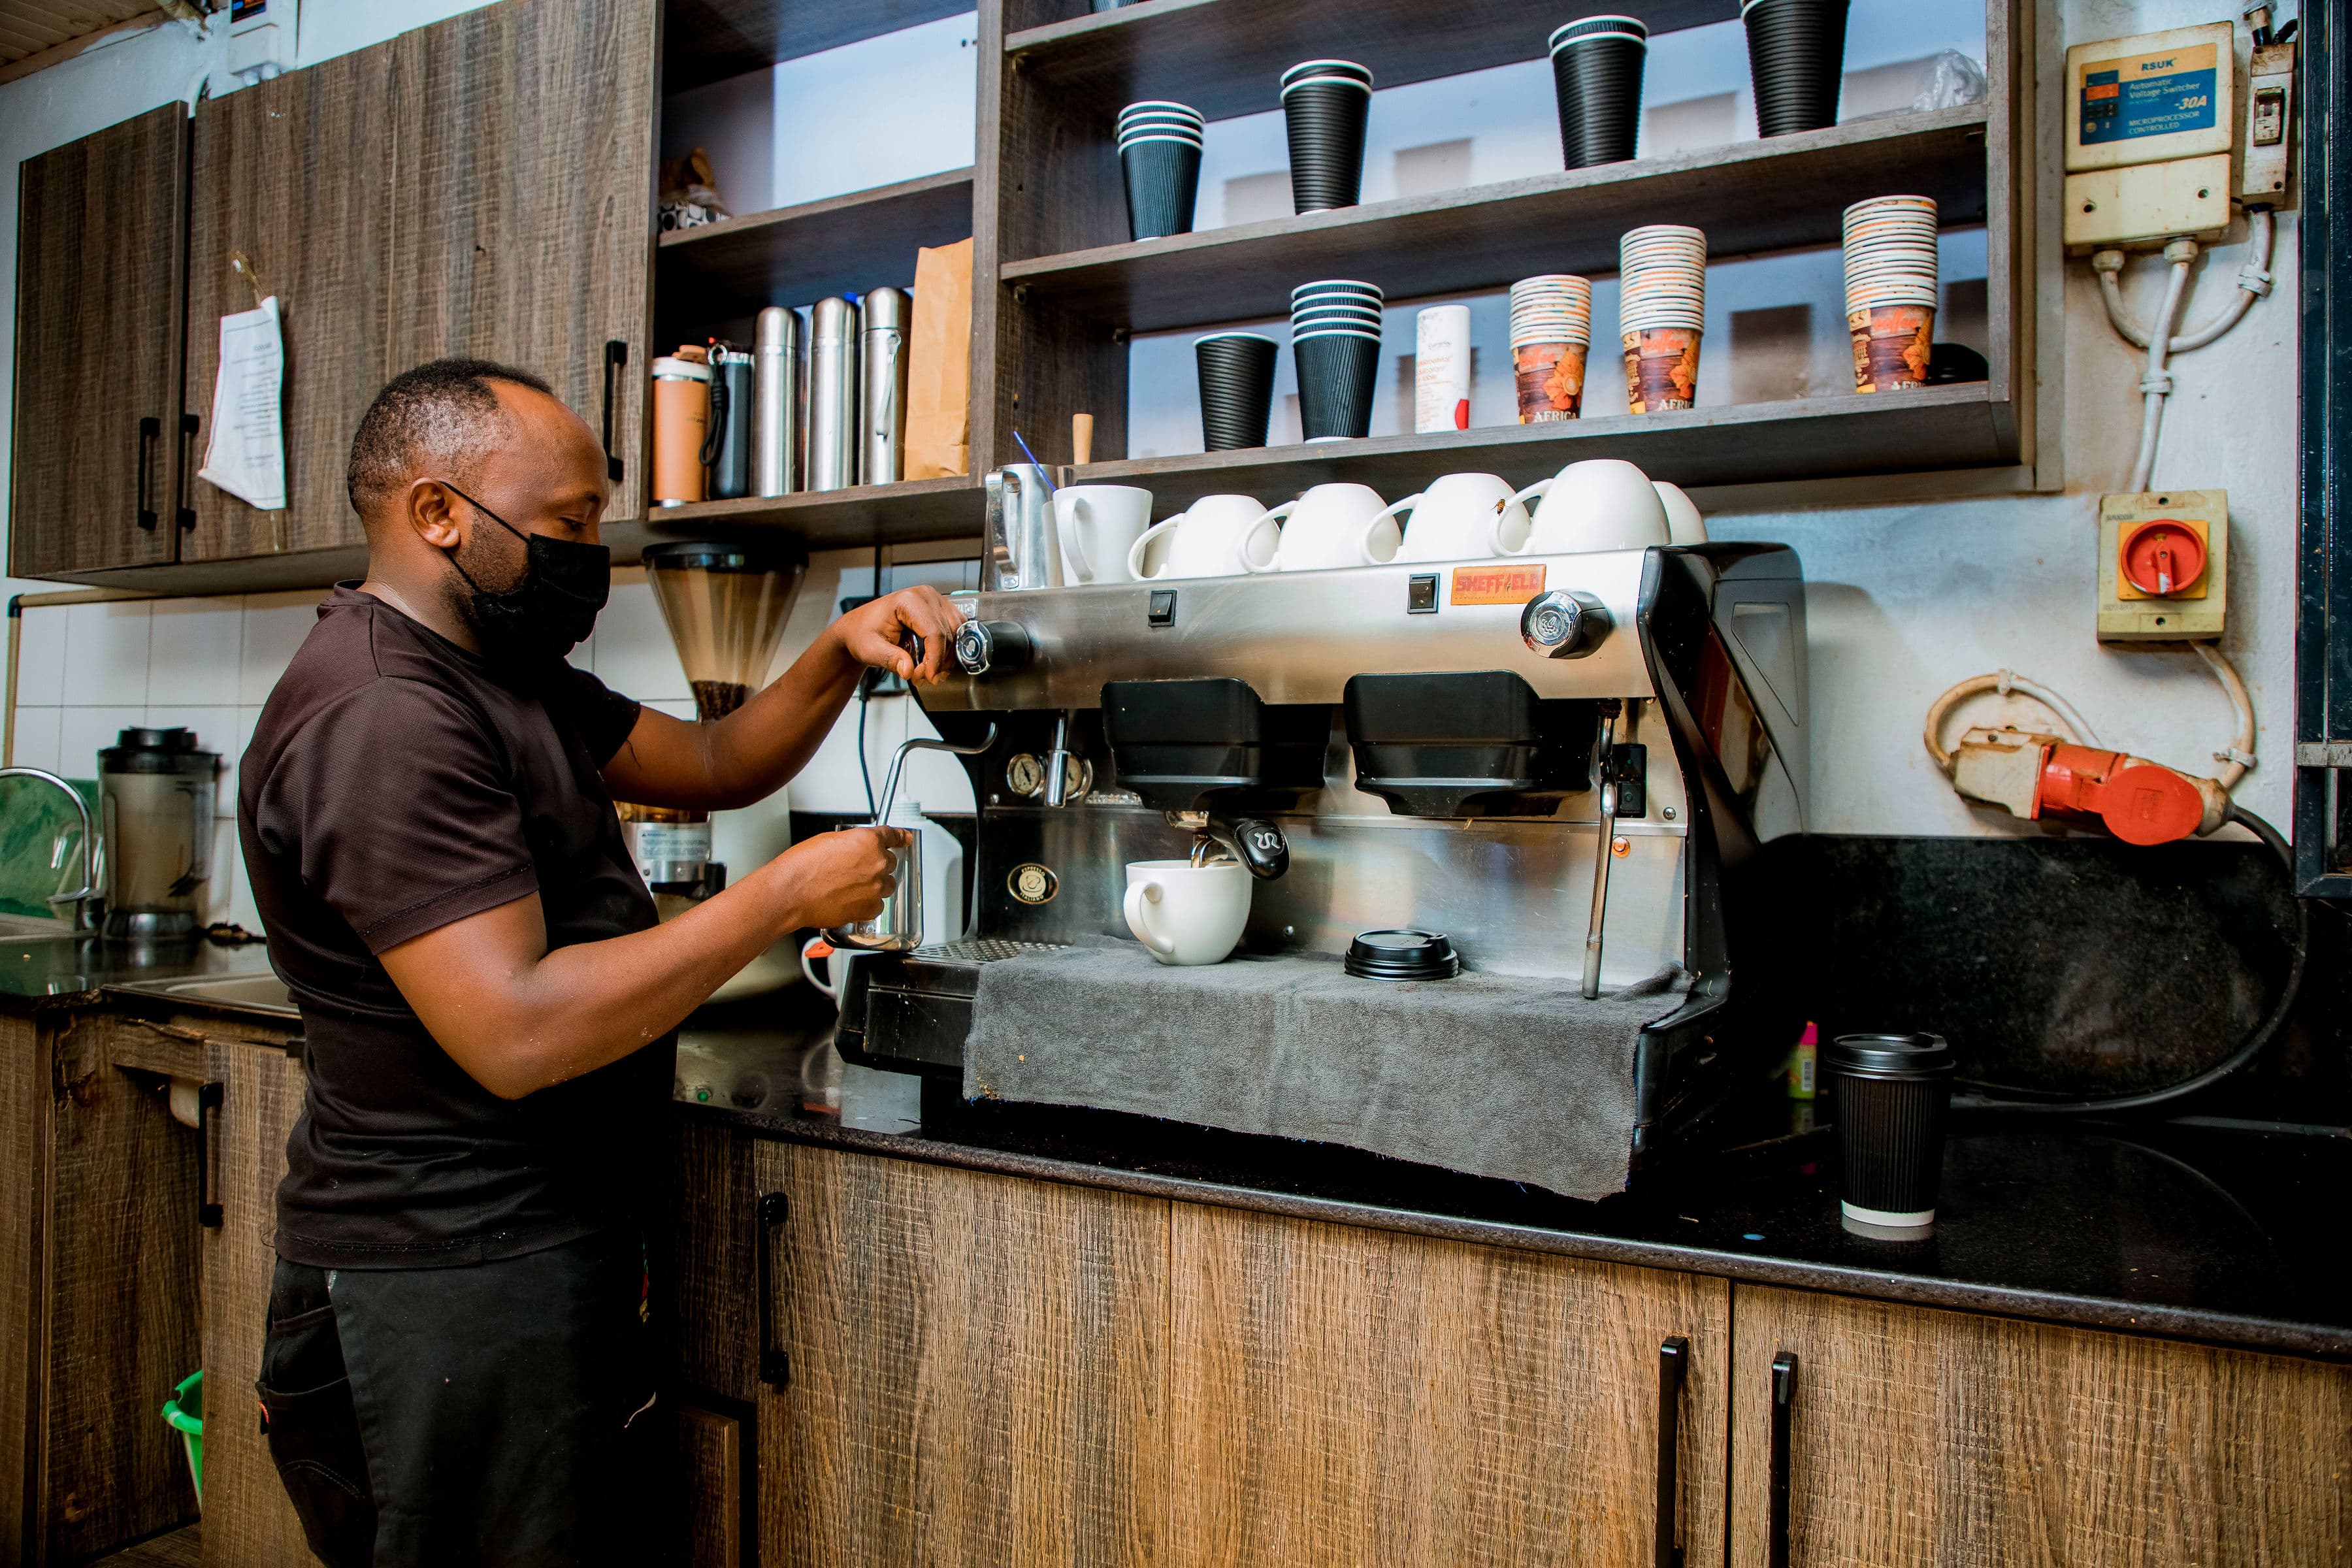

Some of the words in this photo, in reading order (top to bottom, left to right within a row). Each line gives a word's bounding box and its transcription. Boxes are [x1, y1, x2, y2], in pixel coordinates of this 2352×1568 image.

[2141, 59, 2174, 71] RSUK
[2129, 110, 2200, 126] MICROPROCESSOR
[2129, 122, 2180, 135] CONTROLLED
[1873, 308, 1919, 333] coffee
[1533, 410, 1577, 423] AFRICA
